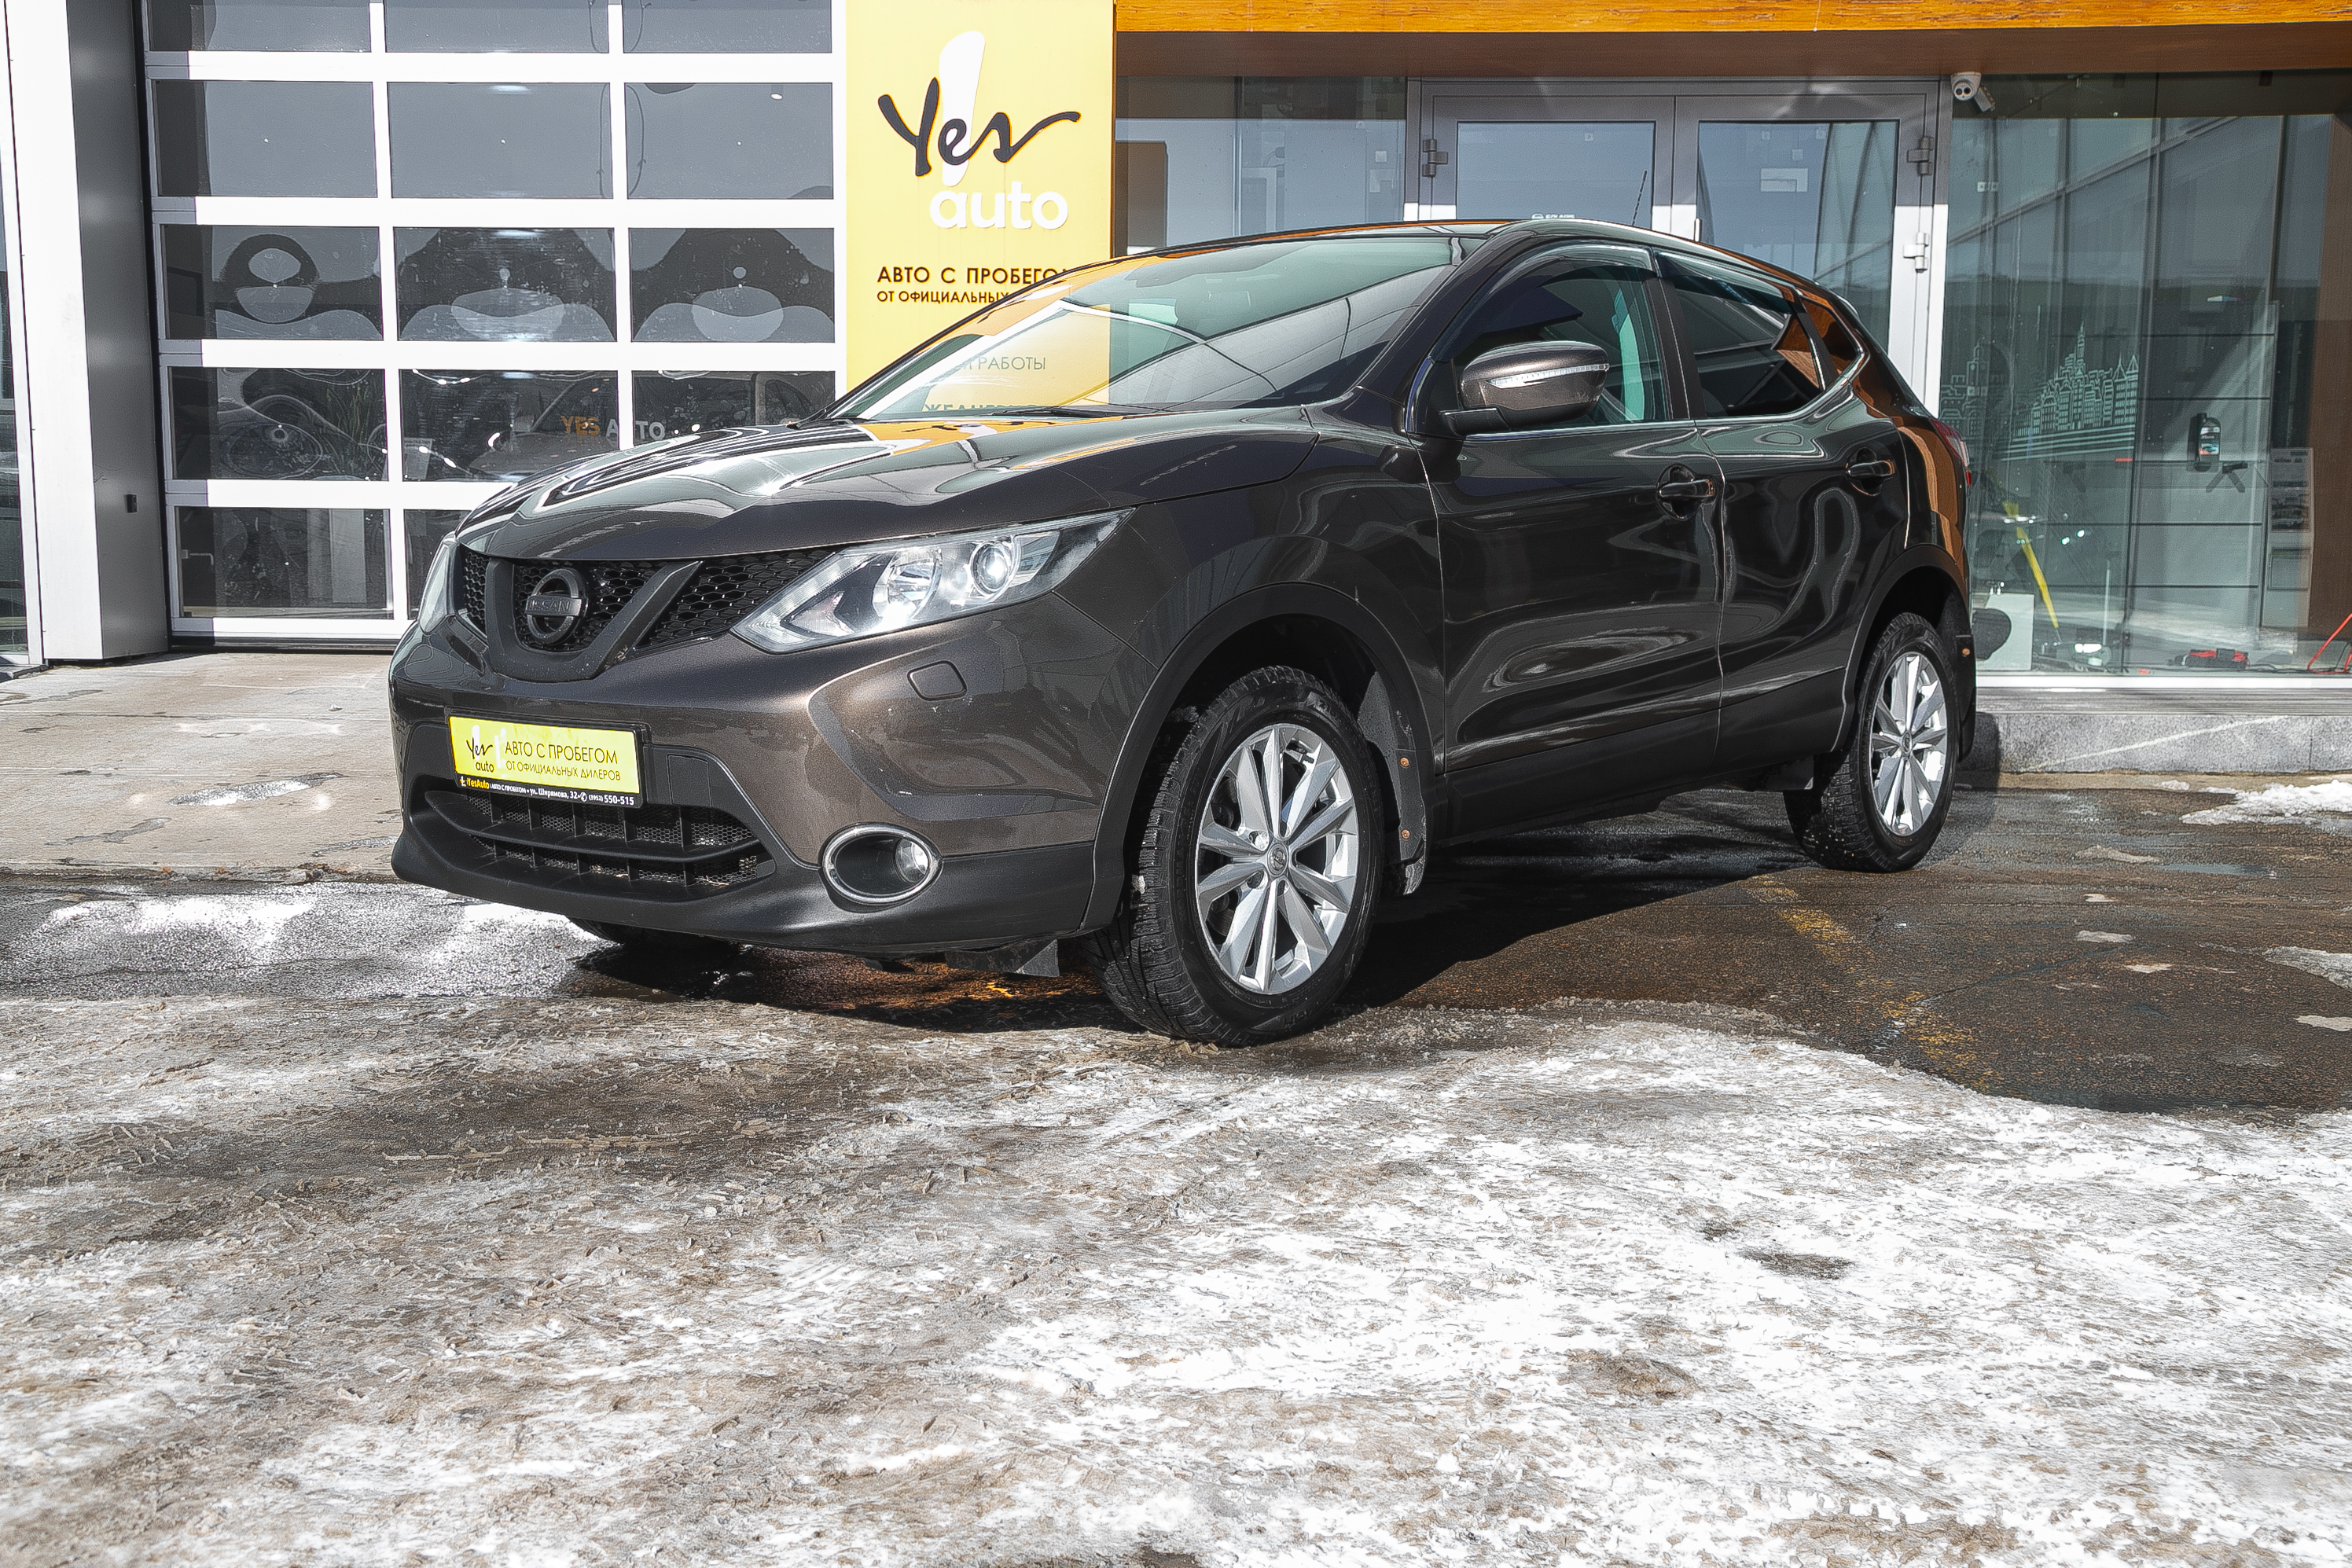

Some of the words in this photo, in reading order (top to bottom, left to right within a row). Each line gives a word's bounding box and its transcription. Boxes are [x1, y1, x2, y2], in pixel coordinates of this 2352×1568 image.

[877, 77, 1081, 177] Yes
[929, 181, 1068, 230] auto
[876, 266, 930, 285] АВТО
[940, 267, 956, 285] С
[966, 267, 1068, 285] ПРОБЕГО
[876, 291, 895, 303] ОТ
[978, 356, 1047, 370] РАБОТЫ
[560, 416, 601, 436] YES
[605, 419, 666, 441] ATO
[465, 737, 494, 760] Yes
[505, 741, 533, 757] АВТО
[536, 743, 546, 758] С
[548, 744, 618, 765] ПРОБЕГОМ
[475, 761, 495, 773] auto
[505, 760, 516, 771] ОТ
[516, 761, 579, 778] ОФИЦИАЛЬНЫХ
[580, 768, 621, 781] ДИЛЕРОВ
[466, 777, 490, 790] YesAuto
[604, 795, 634, 806] 550-515
